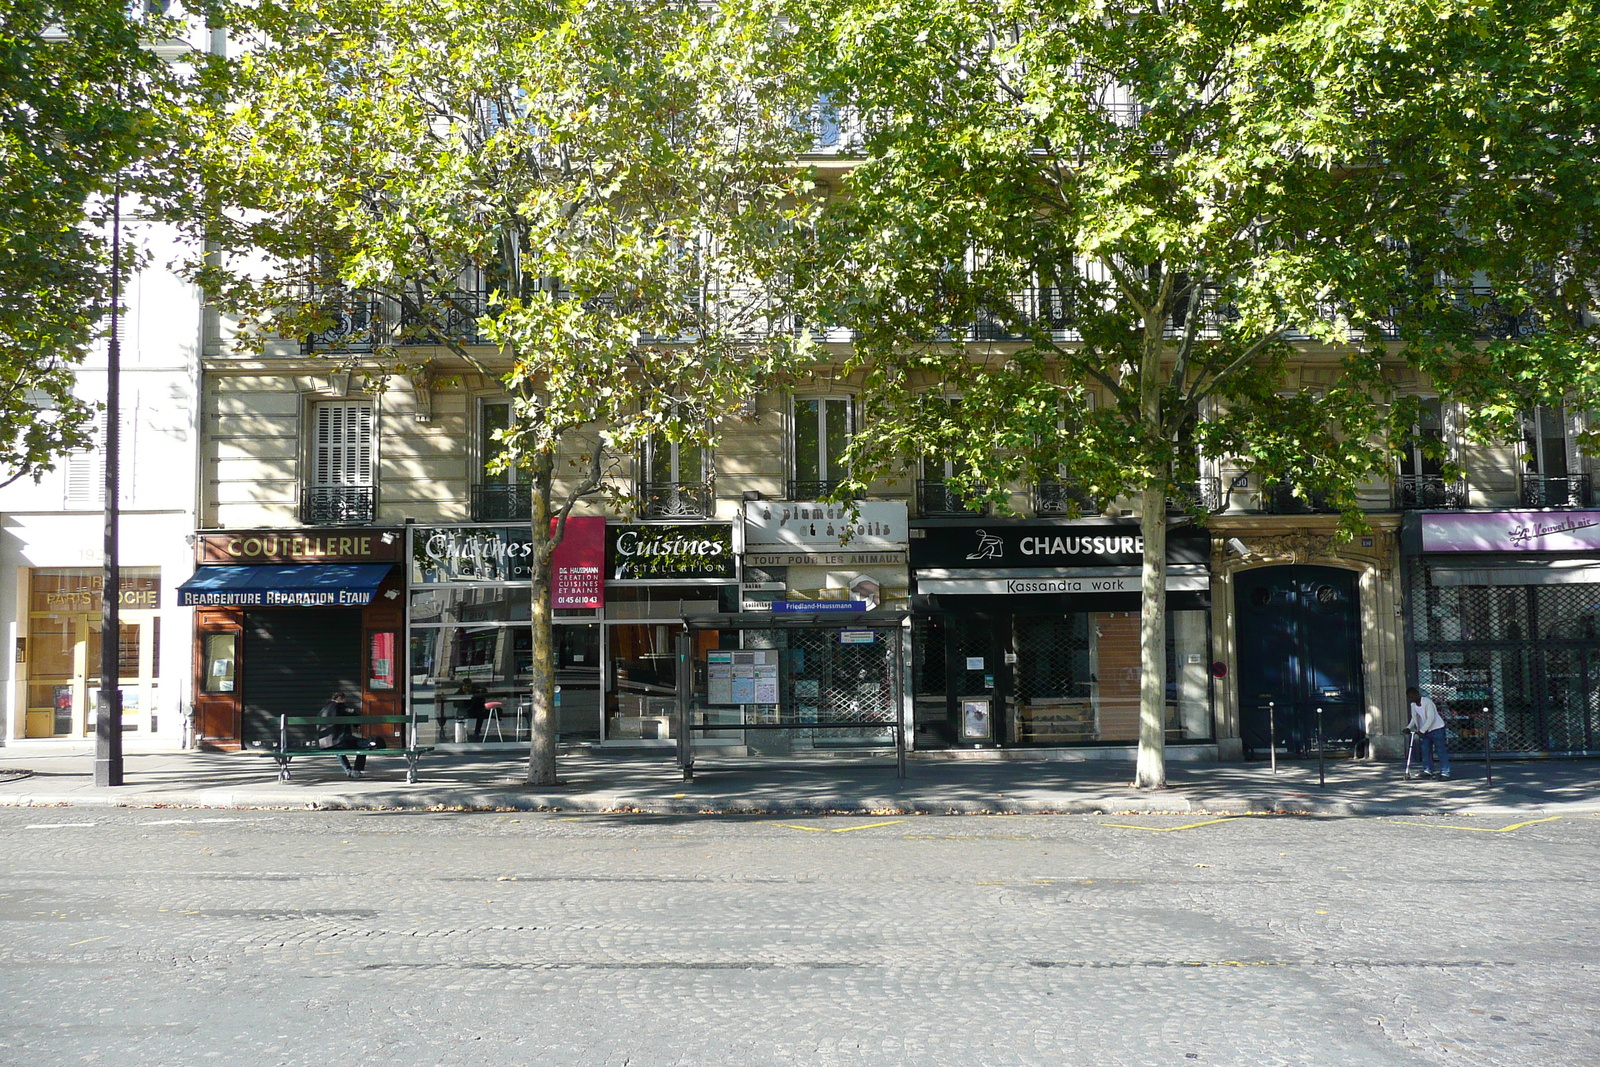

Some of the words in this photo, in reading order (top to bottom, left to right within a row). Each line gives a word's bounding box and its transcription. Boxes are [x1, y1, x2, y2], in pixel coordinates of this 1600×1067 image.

[780, 506, 845, 527] plumes
[800, 523, 816, 536] et
[227, 537, 371, 557] COUTELLERIE
[425, 534, 533, 559] Cuisines
[616, 531, 724, 556] Cuisines
[753, 556, 781, 565] TOUT
[788, 556, 818, 565] POUR
[825, 556, 844, 564] LES
[850, 555, 900, 564] ANIMAUX
[616, 564, 725, 573] INSTALLATION
[1007, 580, 1082, 593] Kassandra
[1092, 579, 1125, 591] work
[46, 591, 92, 605] PARIS
[745, 602, 771, 610] toilettag
[786, 602, 853, 610] Friedland-Haussmann
